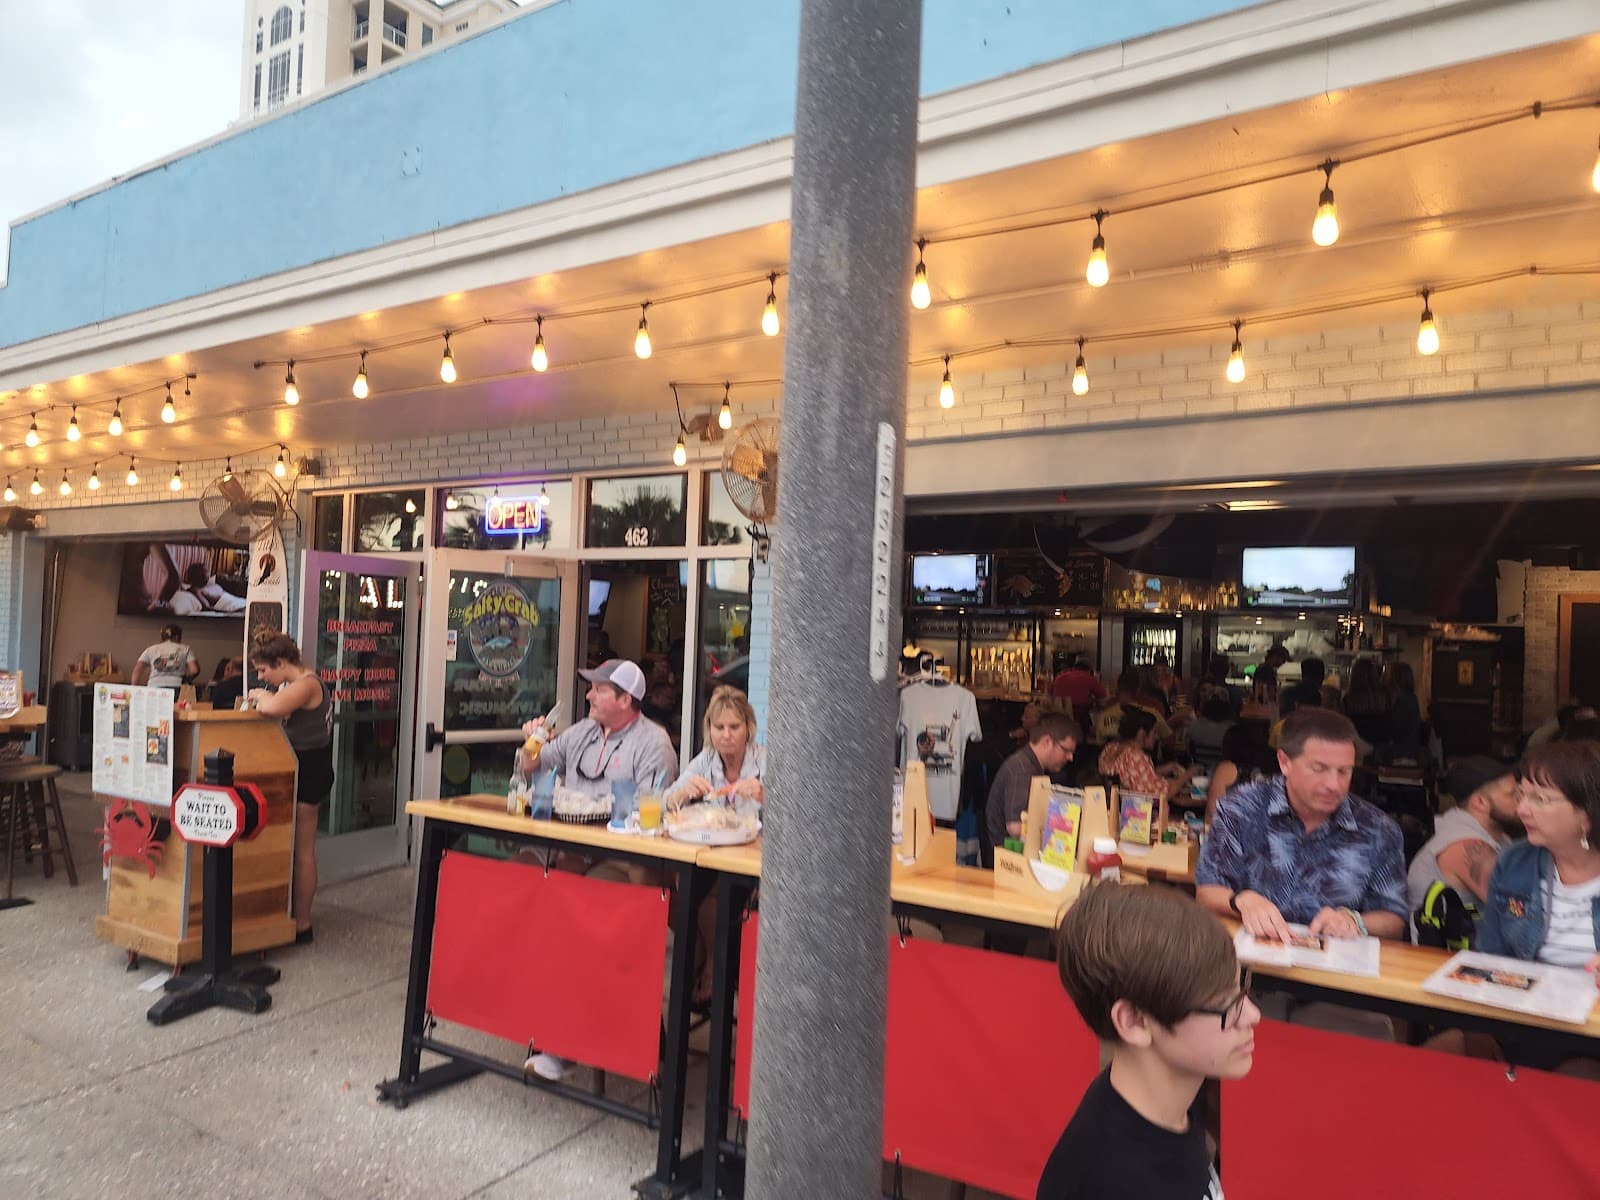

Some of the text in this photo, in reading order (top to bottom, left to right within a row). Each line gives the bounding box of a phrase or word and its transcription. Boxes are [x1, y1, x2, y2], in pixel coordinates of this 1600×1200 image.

[488, 501, 538, 529] OPEN
[624, 527, 648, 546] 462
[463, 594, 503, 627] Salty
[504, 594, 540, 628] Crab
[326, 620, 393, 633] BREAKFAST
[343, 638, 377, 652] PIZZA
[320, 668, 396, 681] HAPPY HOUR
[354, 688, 391, 701] MUSIC
[186, 801, 226, 816] WAIT TO
[180, 815, 233, 830] BE SEATED
